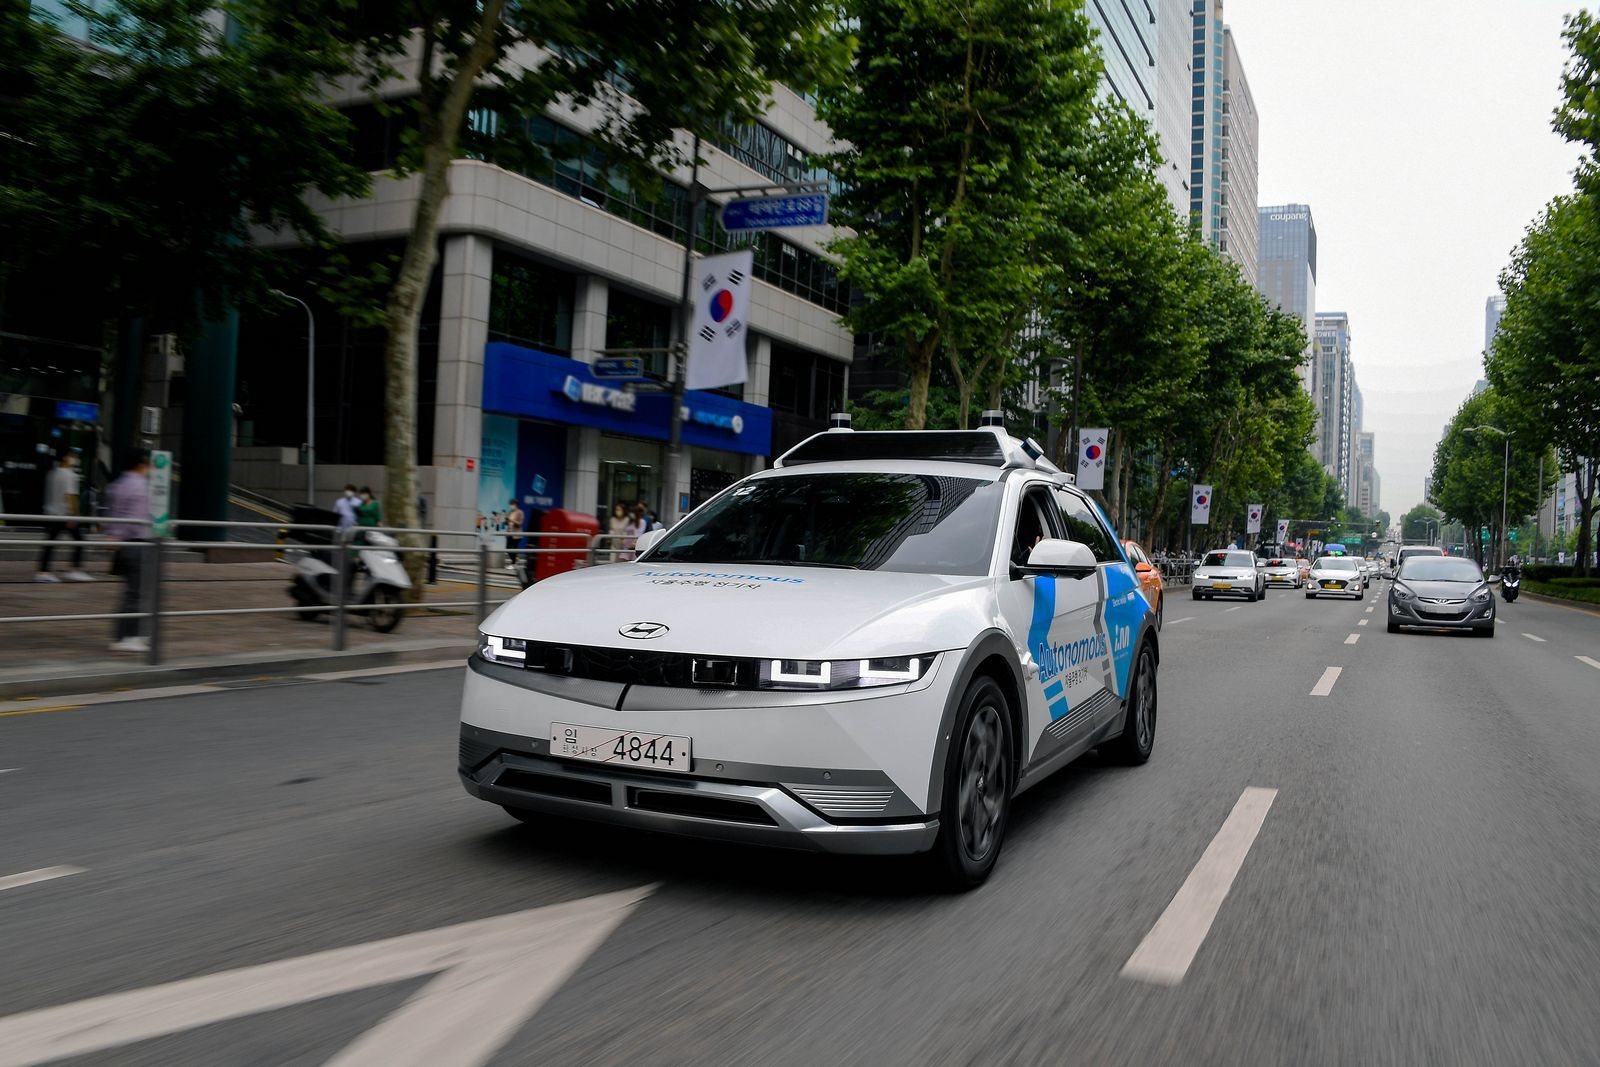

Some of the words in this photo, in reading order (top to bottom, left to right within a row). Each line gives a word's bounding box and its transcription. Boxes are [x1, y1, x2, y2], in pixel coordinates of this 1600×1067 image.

[1270, 212, 1307, 223] coupang
[633, 571, 805, 584] Autonomous
[1039, 633, 1106, 681] Autonomous
[565, 729, 577, 744] 임
[613, 735, 674, 765] 4844
